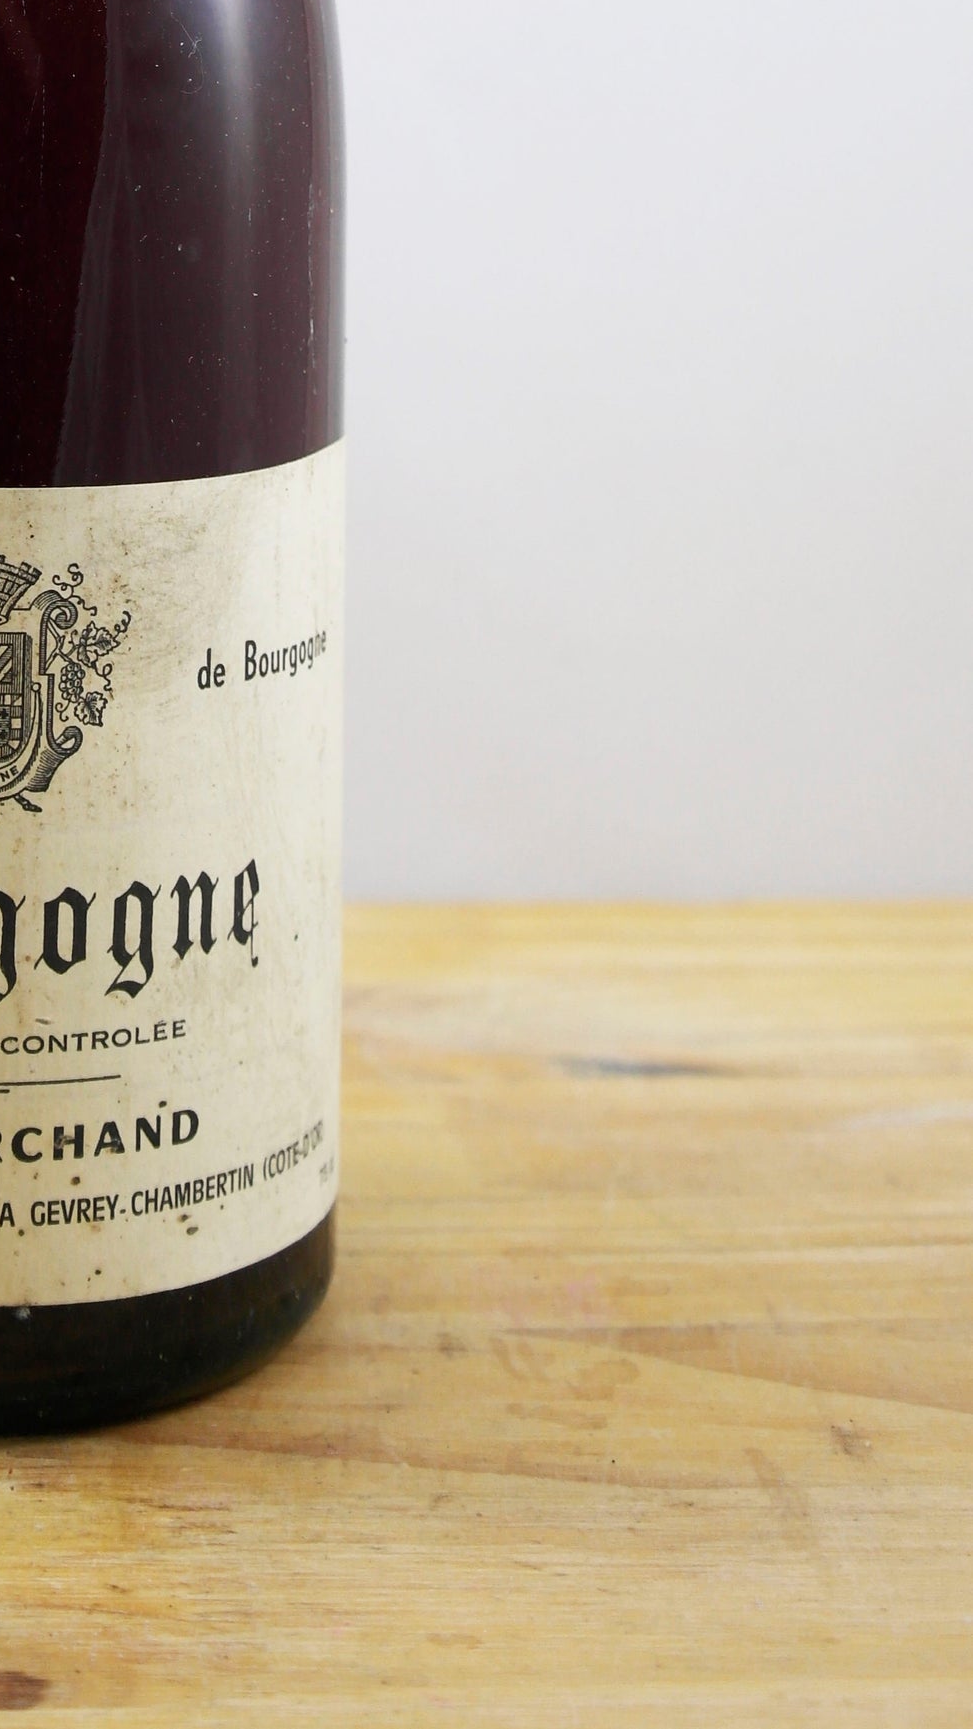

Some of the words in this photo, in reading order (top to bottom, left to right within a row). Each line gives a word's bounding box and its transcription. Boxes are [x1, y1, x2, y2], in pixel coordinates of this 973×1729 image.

[196, 647, 226, 690] de
[243, 629, 327, 683] Bourgogne
[0, 1019, 187, 1055] CONTROLÉE
